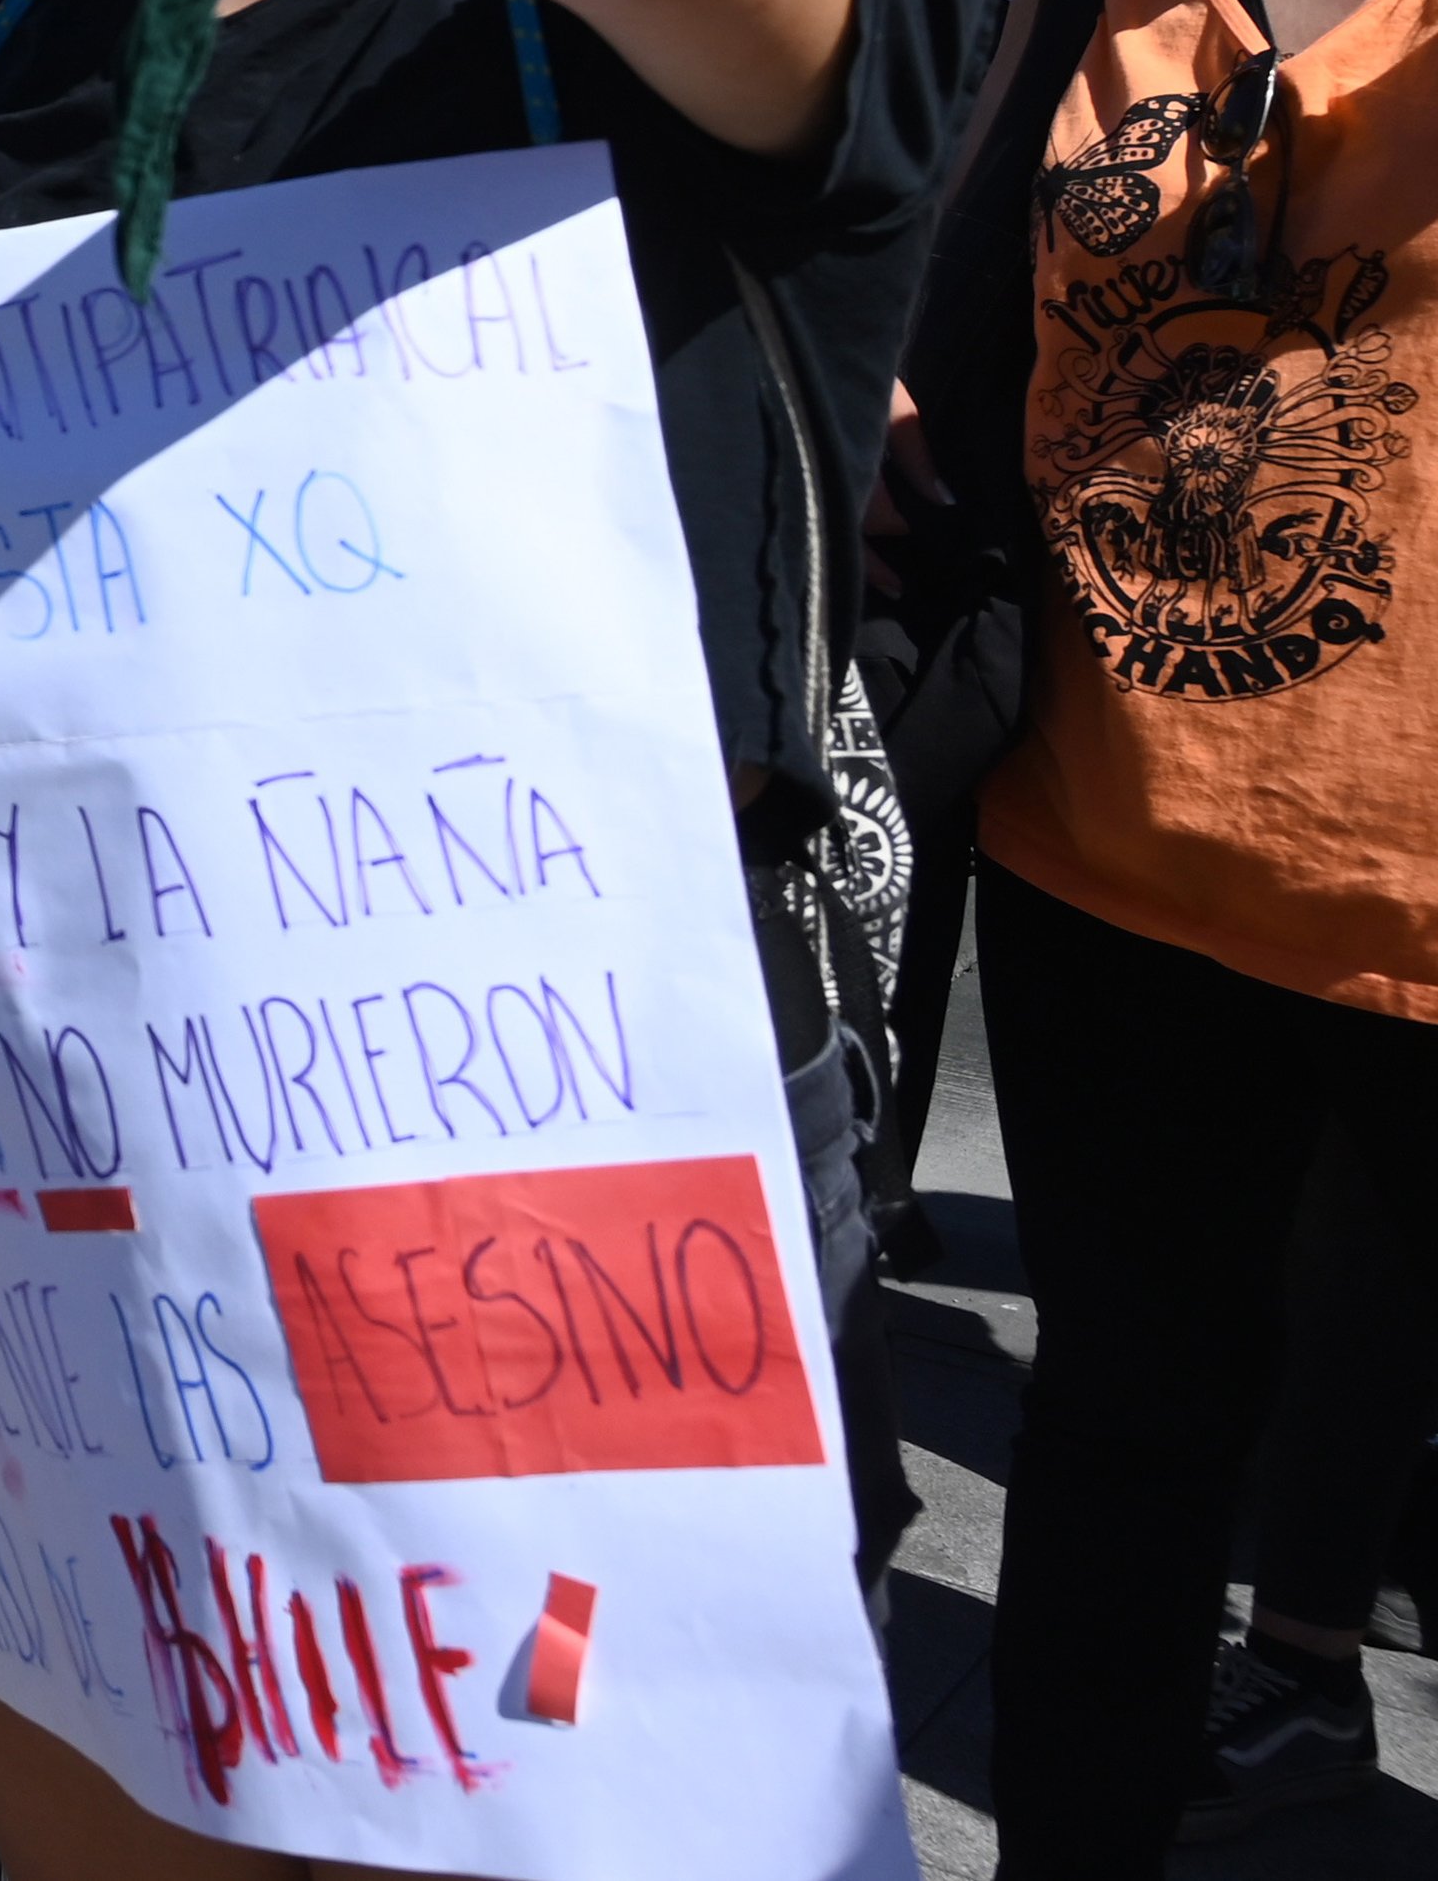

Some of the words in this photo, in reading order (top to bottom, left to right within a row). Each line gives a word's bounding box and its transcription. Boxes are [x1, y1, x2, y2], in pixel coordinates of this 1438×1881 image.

[214, 468, 406, 598] XQ
[78, 805, 213, 944] LA
[147, 972, 638, 1174] MURIERON
[108, 1290, 276, 1473] LAS
[294, 1217, 765, 1426] ASESINO
[36, 1539, 126, 1698] DE
